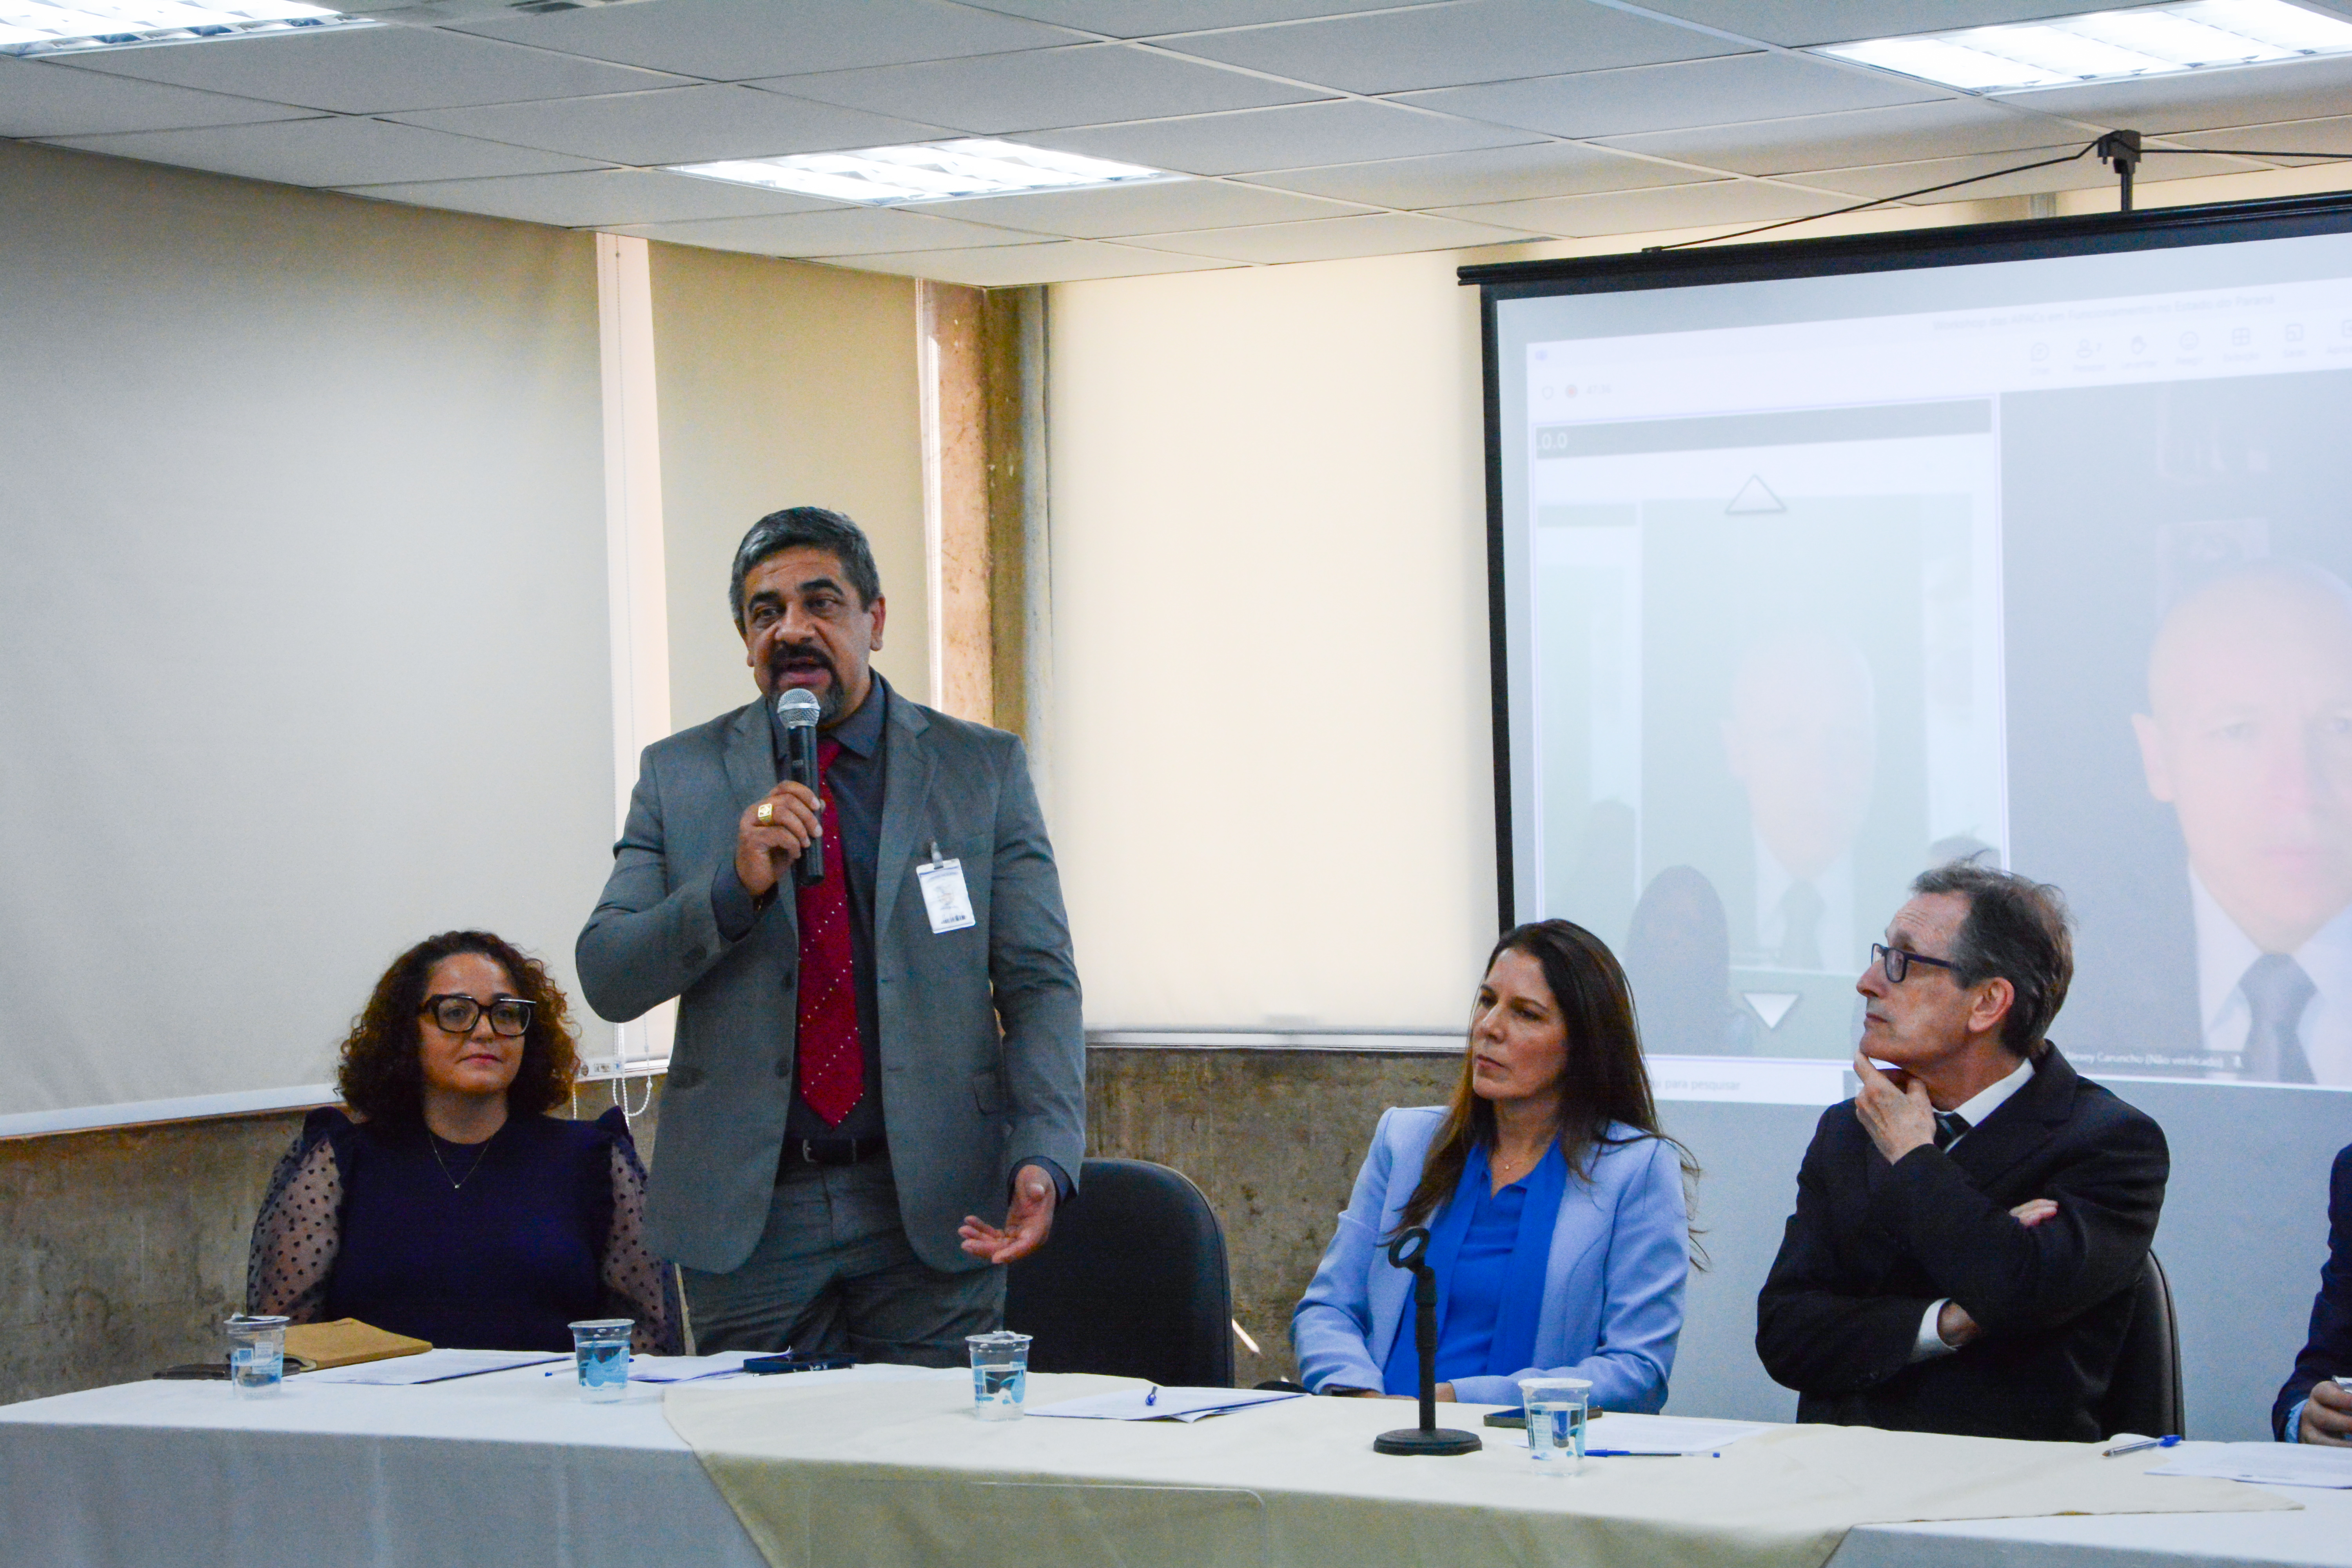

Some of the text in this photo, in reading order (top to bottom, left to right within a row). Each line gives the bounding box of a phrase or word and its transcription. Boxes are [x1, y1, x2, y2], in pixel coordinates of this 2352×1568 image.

[1933, 294, 2275, 330] Workshop das APACs em Funcionamento no Estado do Paraná
[1665, 1080, 1688, 1091] para
[1691, 1080, 1741, 1092] pesquisar
